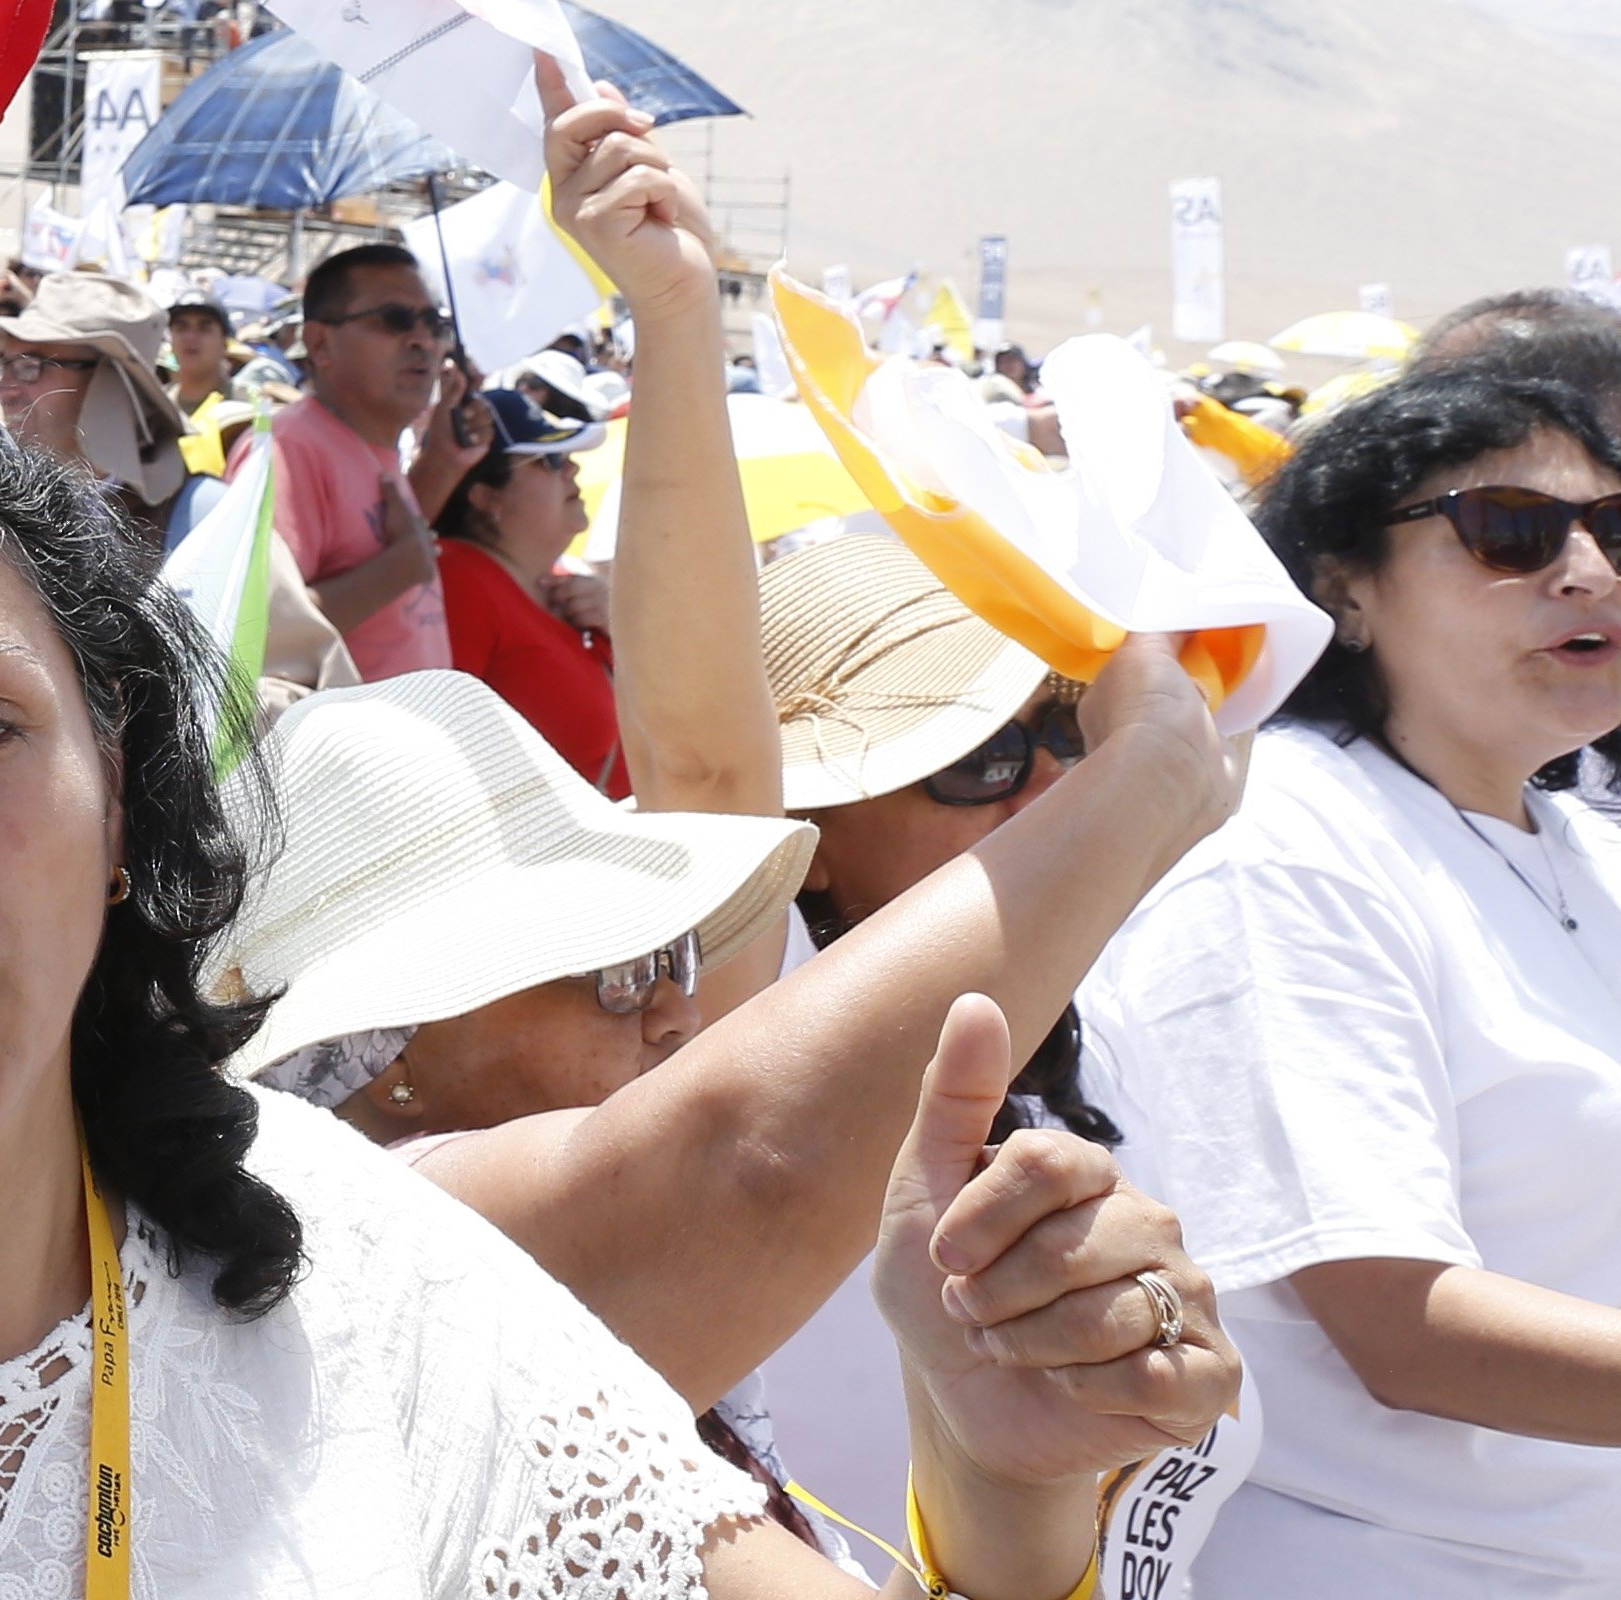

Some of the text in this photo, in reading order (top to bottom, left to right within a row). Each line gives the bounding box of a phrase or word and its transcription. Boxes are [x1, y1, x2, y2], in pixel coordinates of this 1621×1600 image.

[101, 1342, 117, 1387] Papa
[1143, 1456, 1219, 1502] PAZ
[95, 1463, 113, 1558] cachantun
[1125, 1497, 1182, 1552] LES
[1121, 1551, 1172, 1600] DOY
